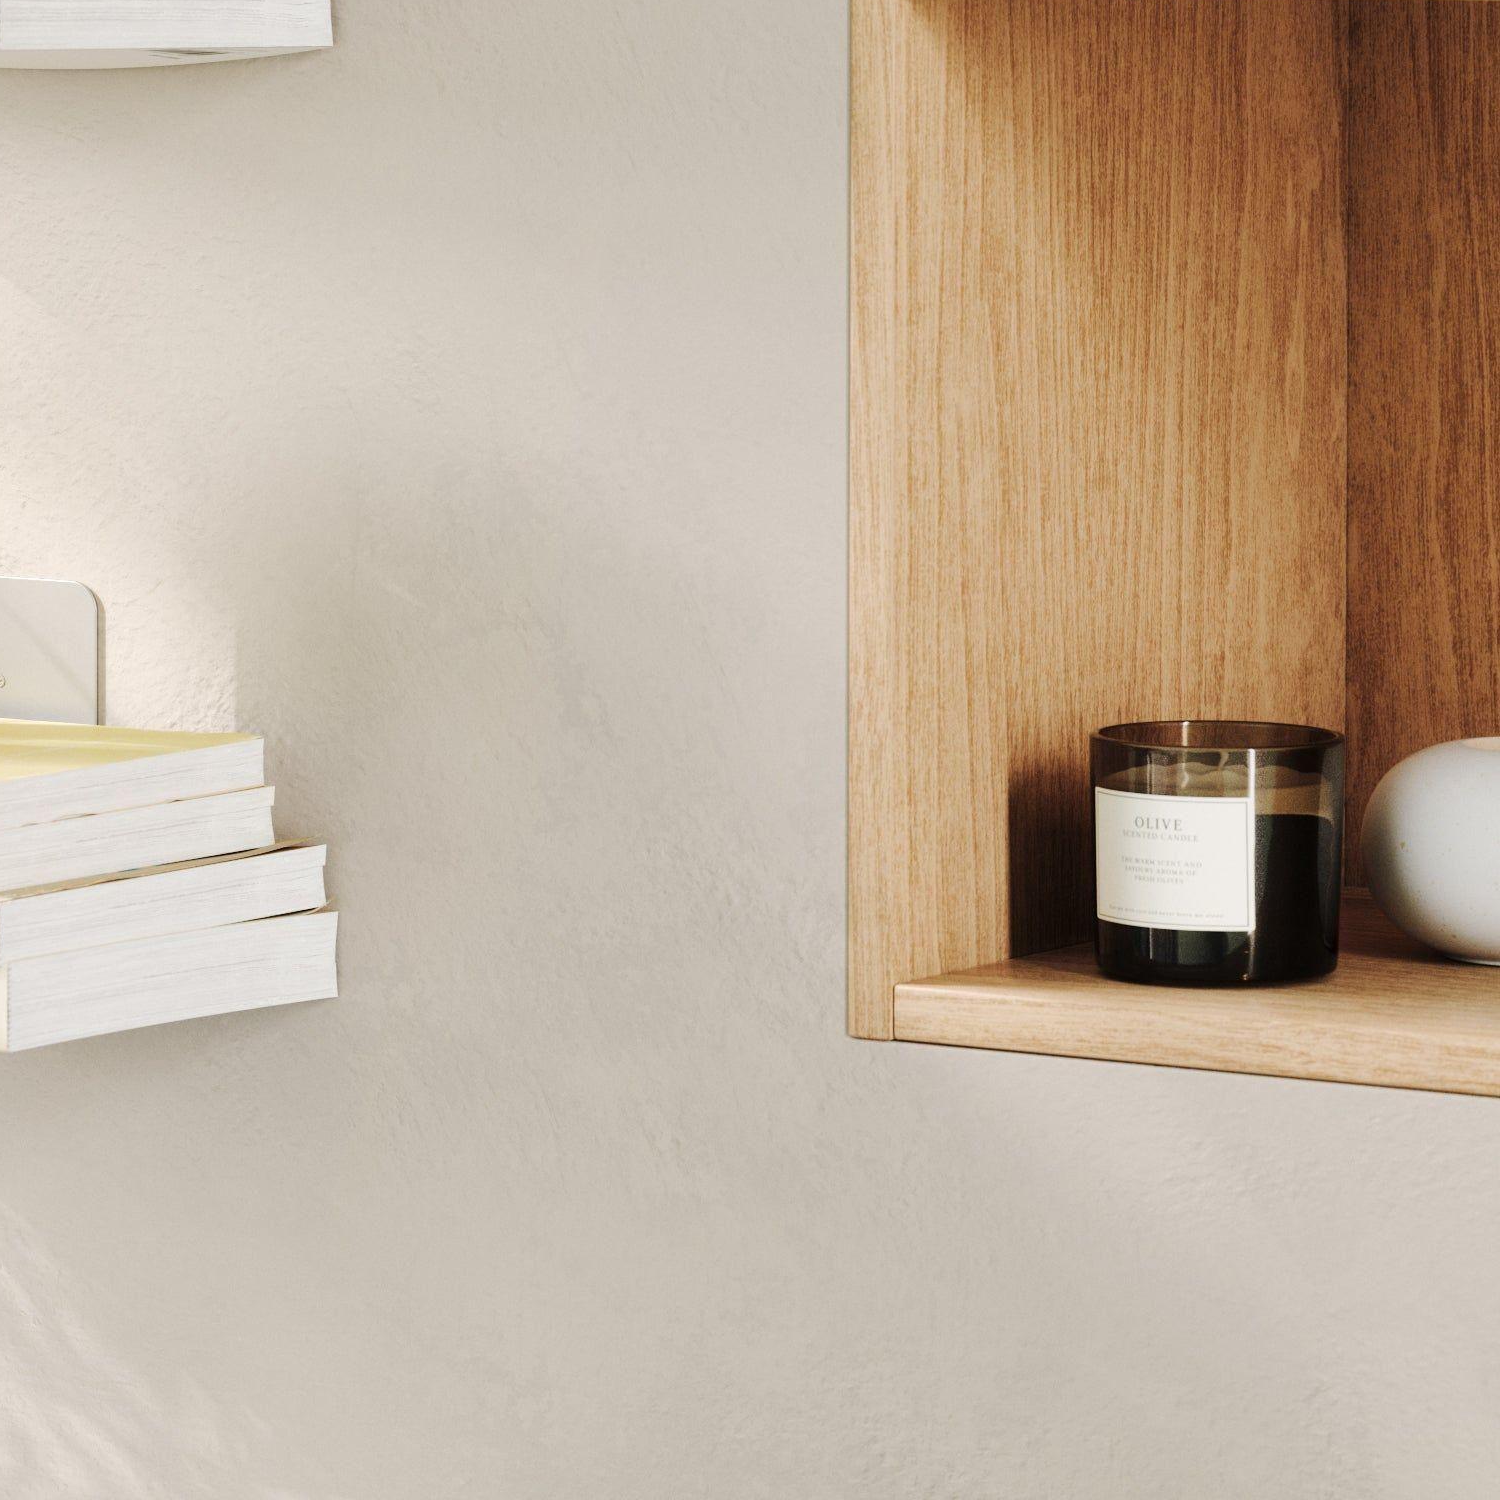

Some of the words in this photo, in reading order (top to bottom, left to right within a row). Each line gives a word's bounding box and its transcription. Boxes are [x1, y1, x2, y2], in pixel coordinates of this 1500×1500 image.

[1134, 816, 1183, 831] OLIVE
[1122, 829, 1159, 840] SCENTED
[1160, 832, 1199, 842] CANDLE
